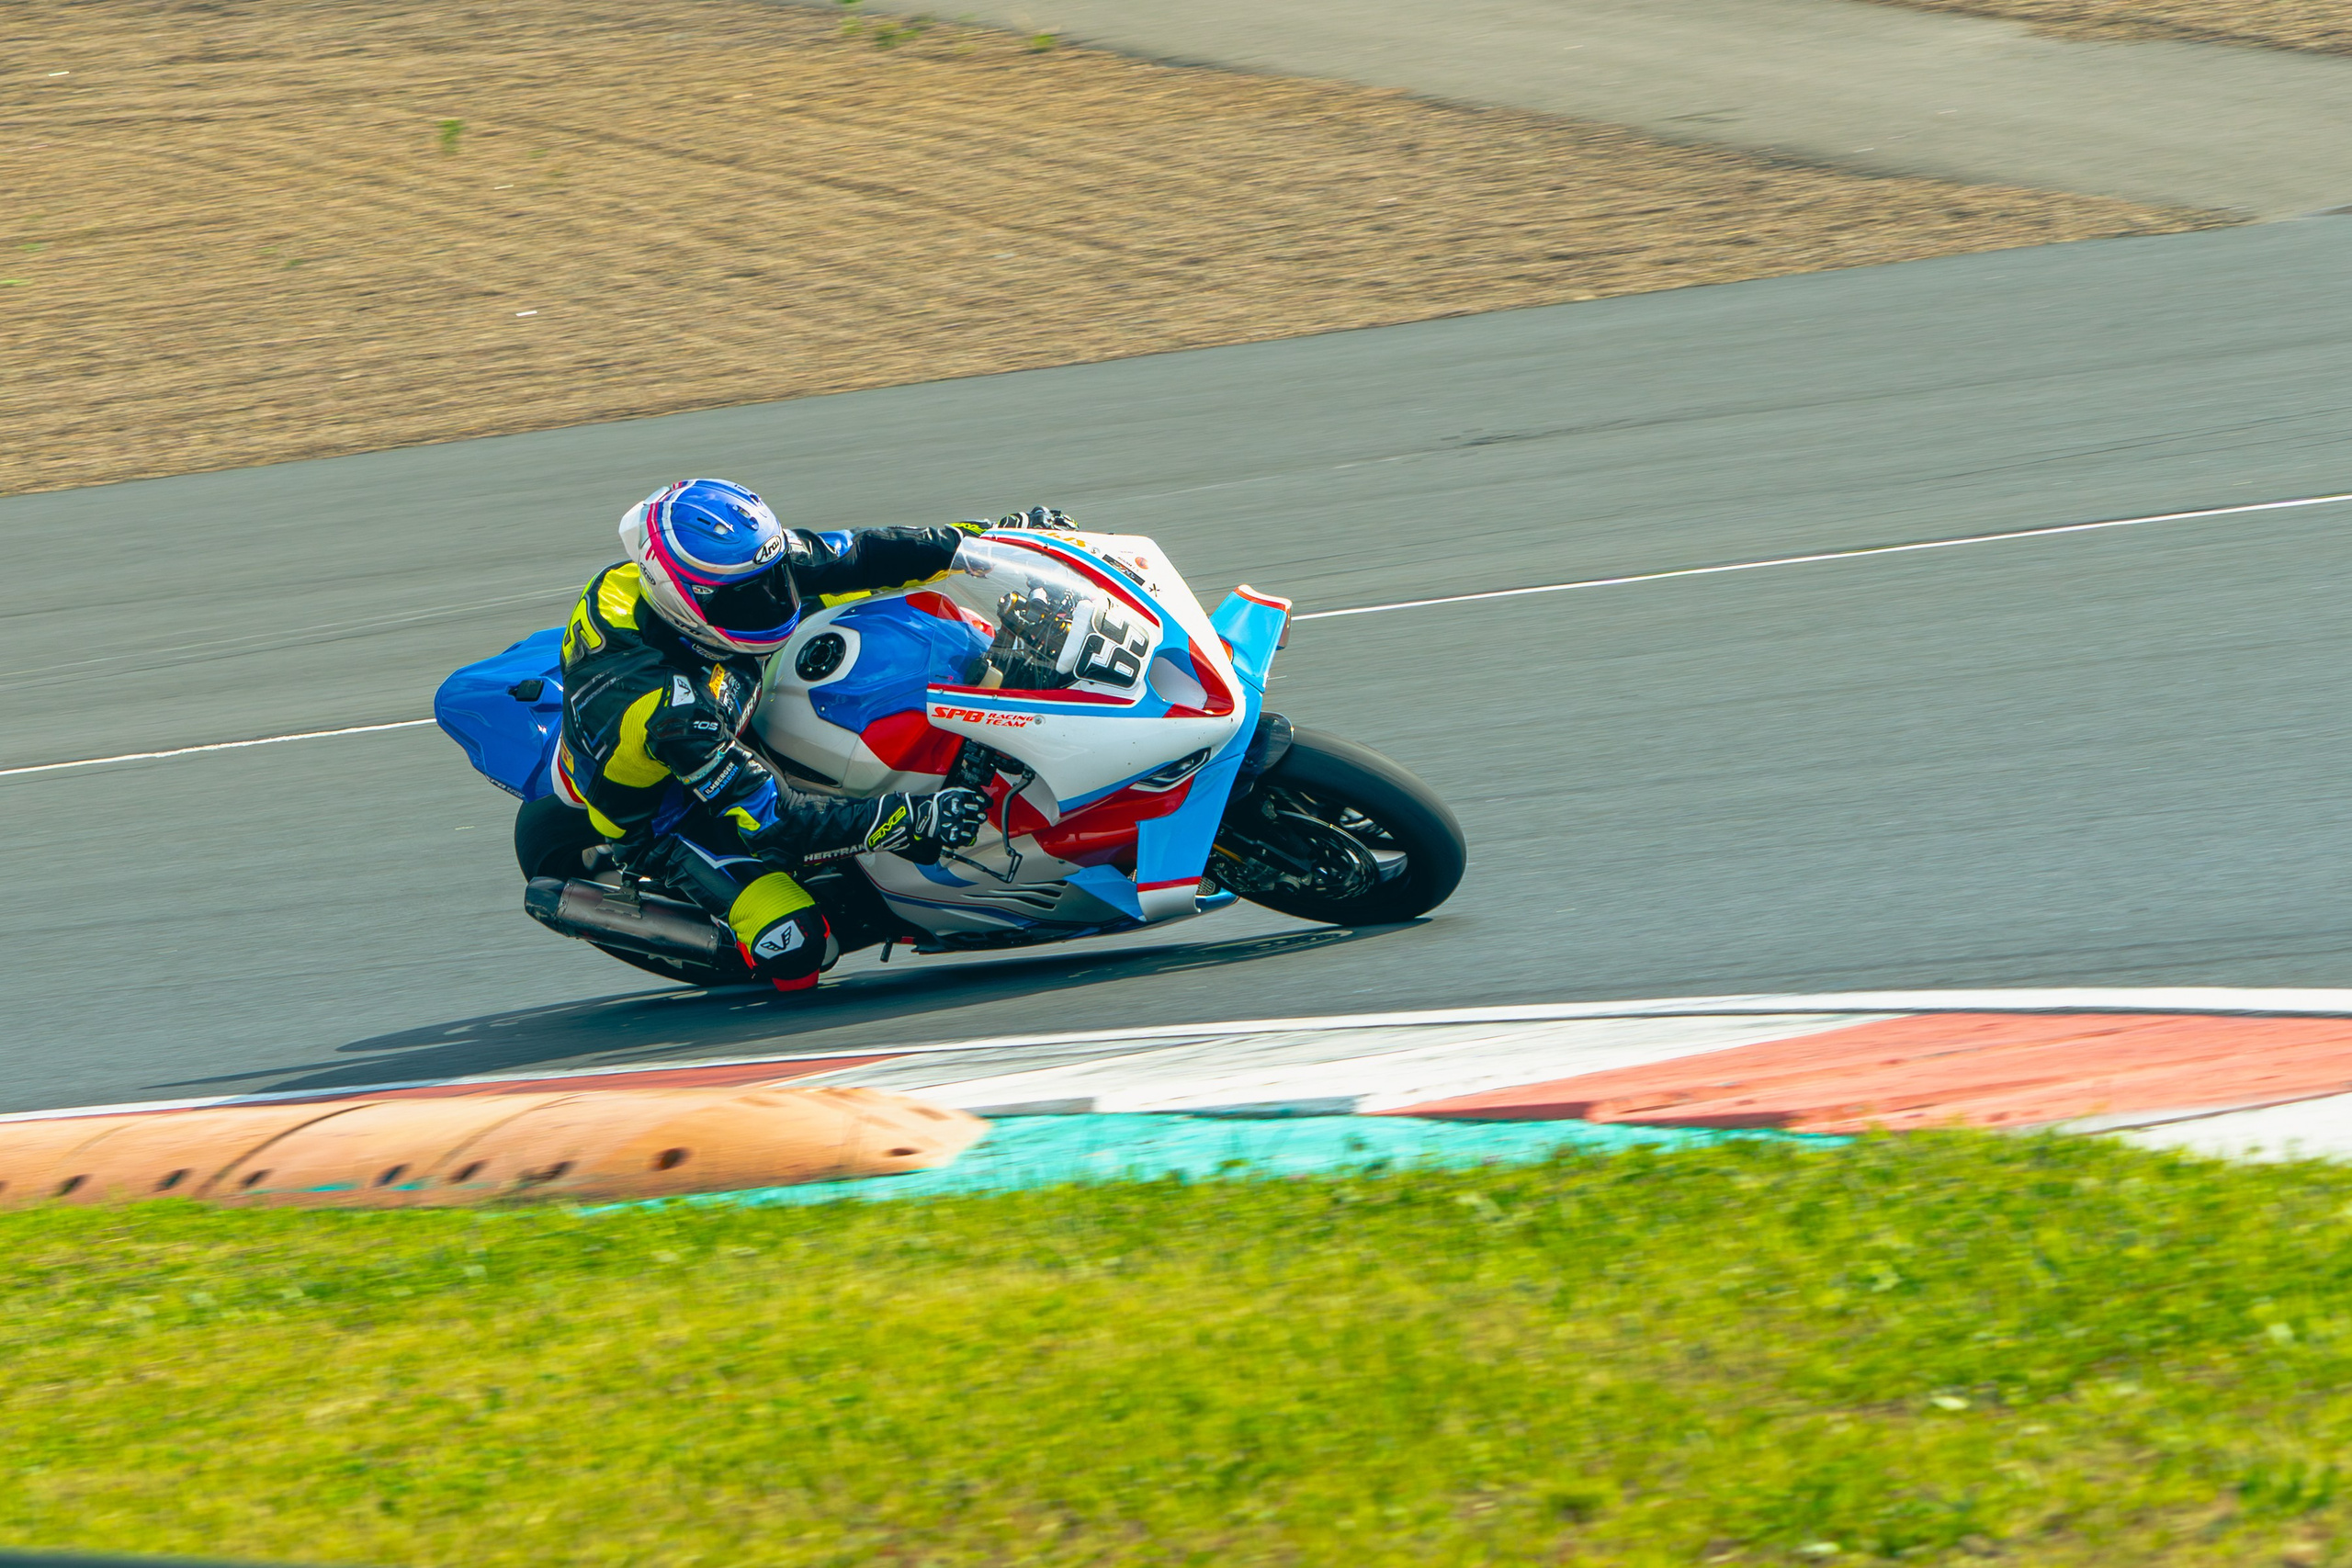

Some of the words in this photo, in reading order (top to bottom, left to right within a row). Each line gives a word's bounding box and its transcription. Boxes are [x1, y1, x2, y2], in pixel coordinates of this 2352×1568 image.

[756, 536, 780, 561] Arai
[932, 706, 985, 723] SPB
[988, 713, 1035, 722] RACING
[986, 718, 1027, 728] TEAM
[705, 761, 735, 795] ILMBERGER
[868, 806, 907, 847] FIVE
